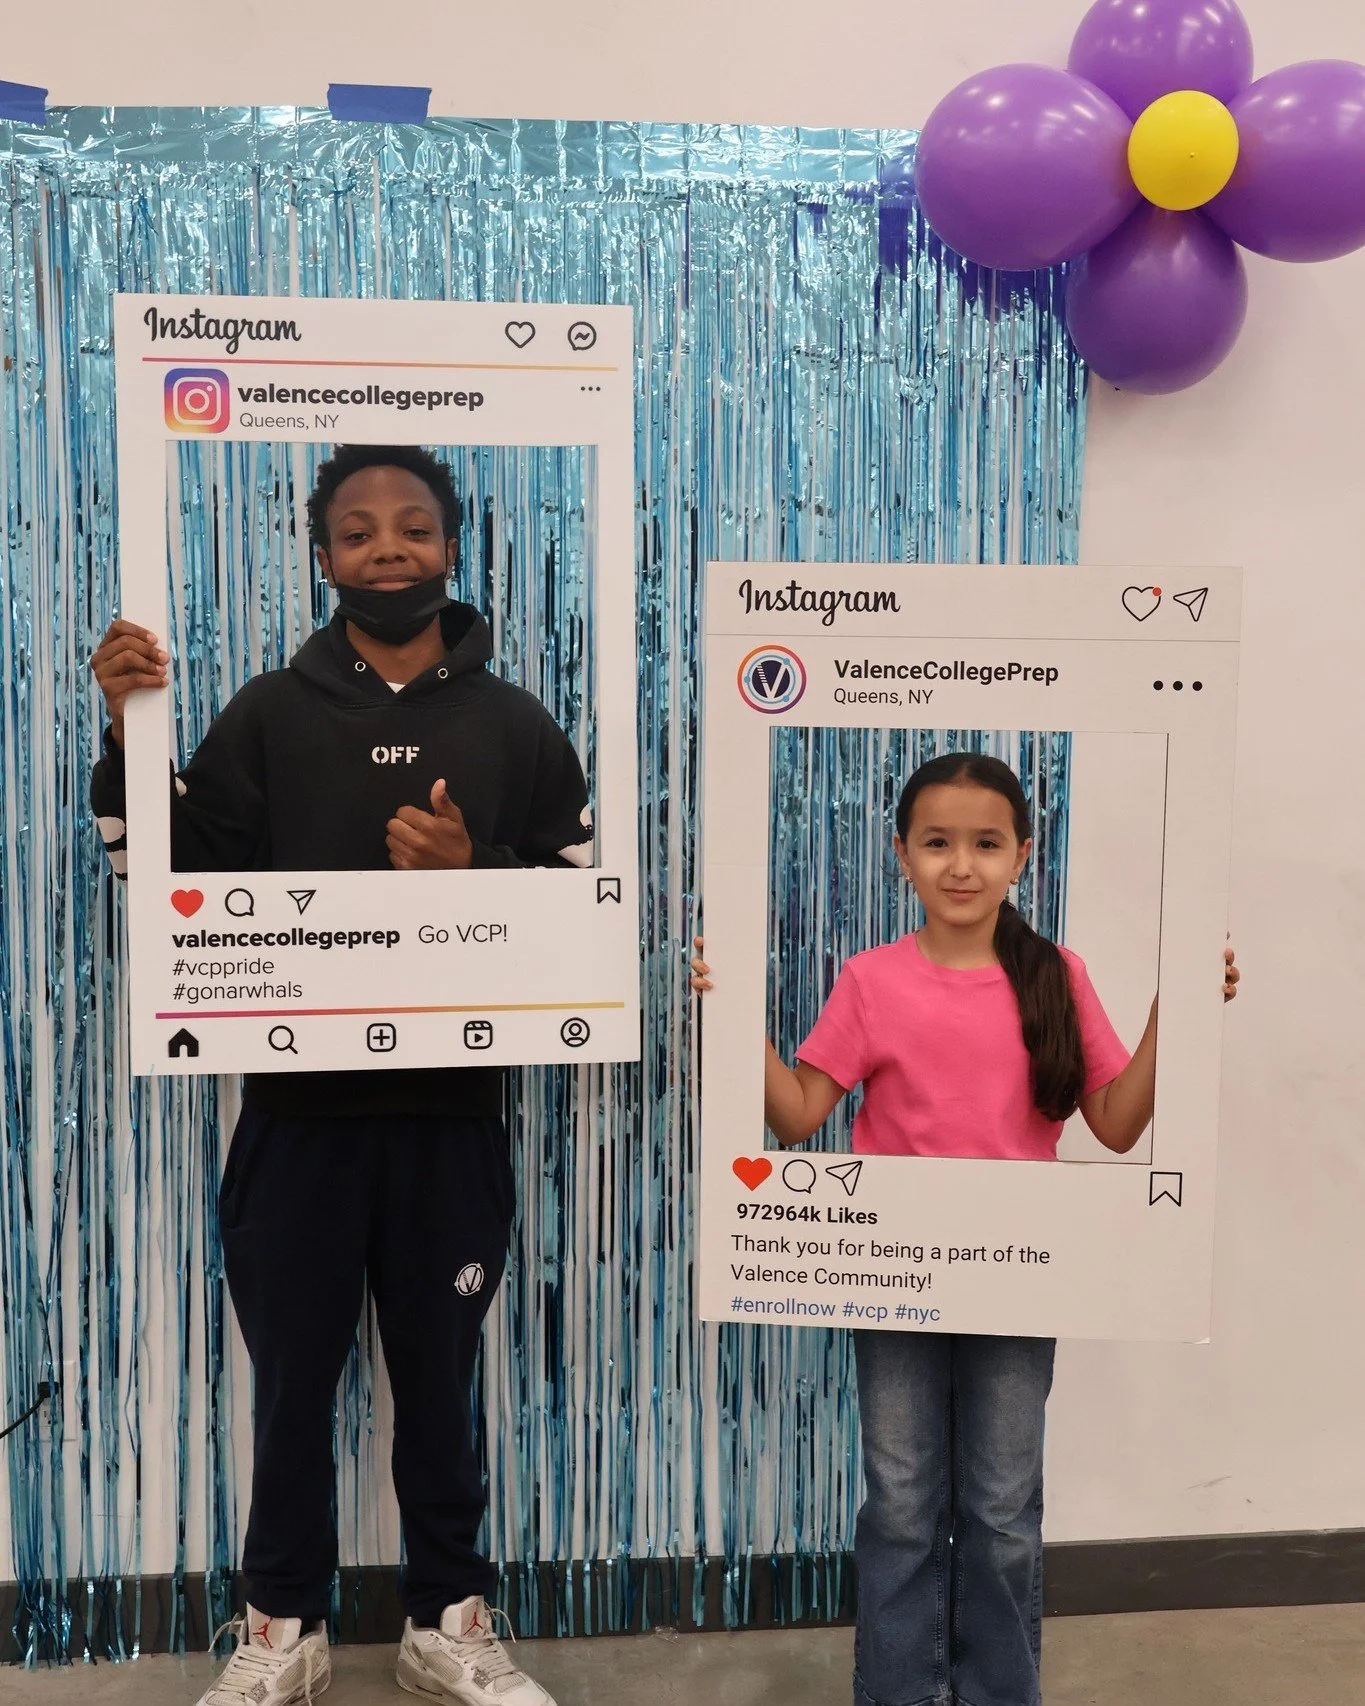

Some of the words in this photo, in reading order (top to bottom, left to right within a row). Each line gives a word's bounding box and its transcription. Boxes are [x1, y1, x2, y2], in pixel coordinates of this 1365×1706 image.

[144, 307, 302, 354] Instagram
[238, 385, 484, 412] valencecollegeprep
[239, 413, 309, 430] Queens,
[315, 414, 340, 429] NY
[738, 578, 901, 626] Instagram
[834, 660, 1059, 687] ValenceCollegePrep
[834, 688, 903, 707] Queens,
[908, 689, 934, 705] NY
[371, 745, 420, 764] OFF
[172, 928, 400, 950] valencecollegeprep
[418, 925, 450, 944] Go
[456, 923, 508, 943] VCP!
[173, 957, 275, 980] #vcppride
[173, 981, 303, 1004] #gonarwhals
[736, 1203, 822, 1223] 972964k
[827, 1206, 878, 1225] Likes
[731, 1235, 791, 1254] Thank
[797, 1241, 831, 1259] you
[837, 1238, 865, 1257] for
[871, 1239, 924, 1264] being
[930, 1246, 941, 1260] a
[948, 1245, 987, 1265] part
[993, 1245, 1014, 1263] of
[1019, 1245, 1050, 1265] the
[731, 1264, 808, 1284] Valence
[814, 1267, 932, 1292] Community!
[731, 1296, 836, 1317] #enrollnow
[842, 1301, 888, 1323] #vcp
[894, 1303, 941, 1325] #nyc
